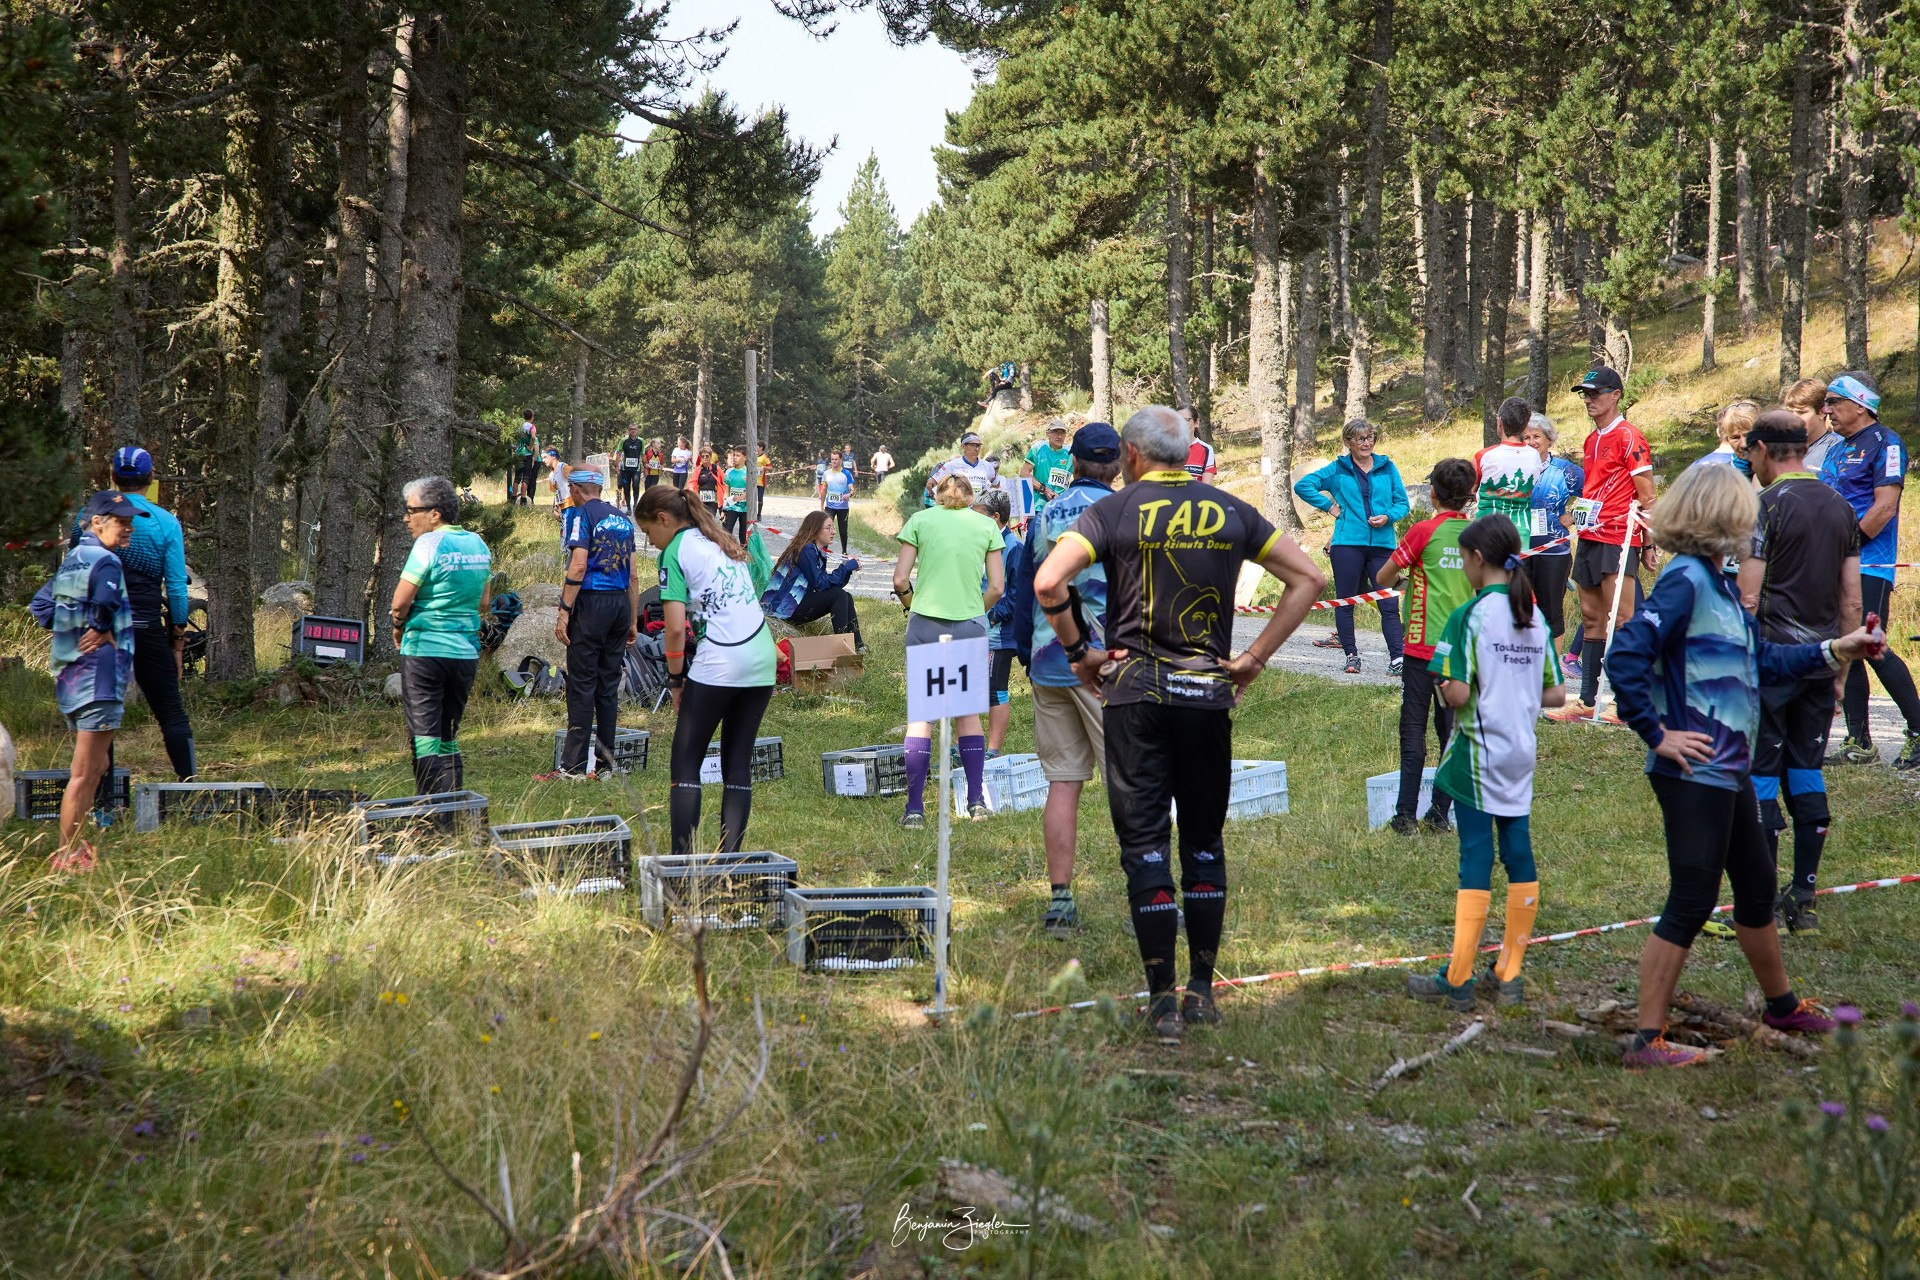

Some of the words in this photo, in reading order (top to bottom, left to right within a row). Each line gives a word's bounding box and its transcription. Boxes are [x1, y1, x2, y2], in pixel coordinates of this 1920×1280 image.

[1051, 474, 1065, 485] 1763
[1138, 499, 1226, 537] TAD
[1138, 541, 1161, 550] Tous
[1164, 539, 1204, 550] Azimuts
[307, 625, 359, 641] 101754
[926, 664, 968, 697] H-1
